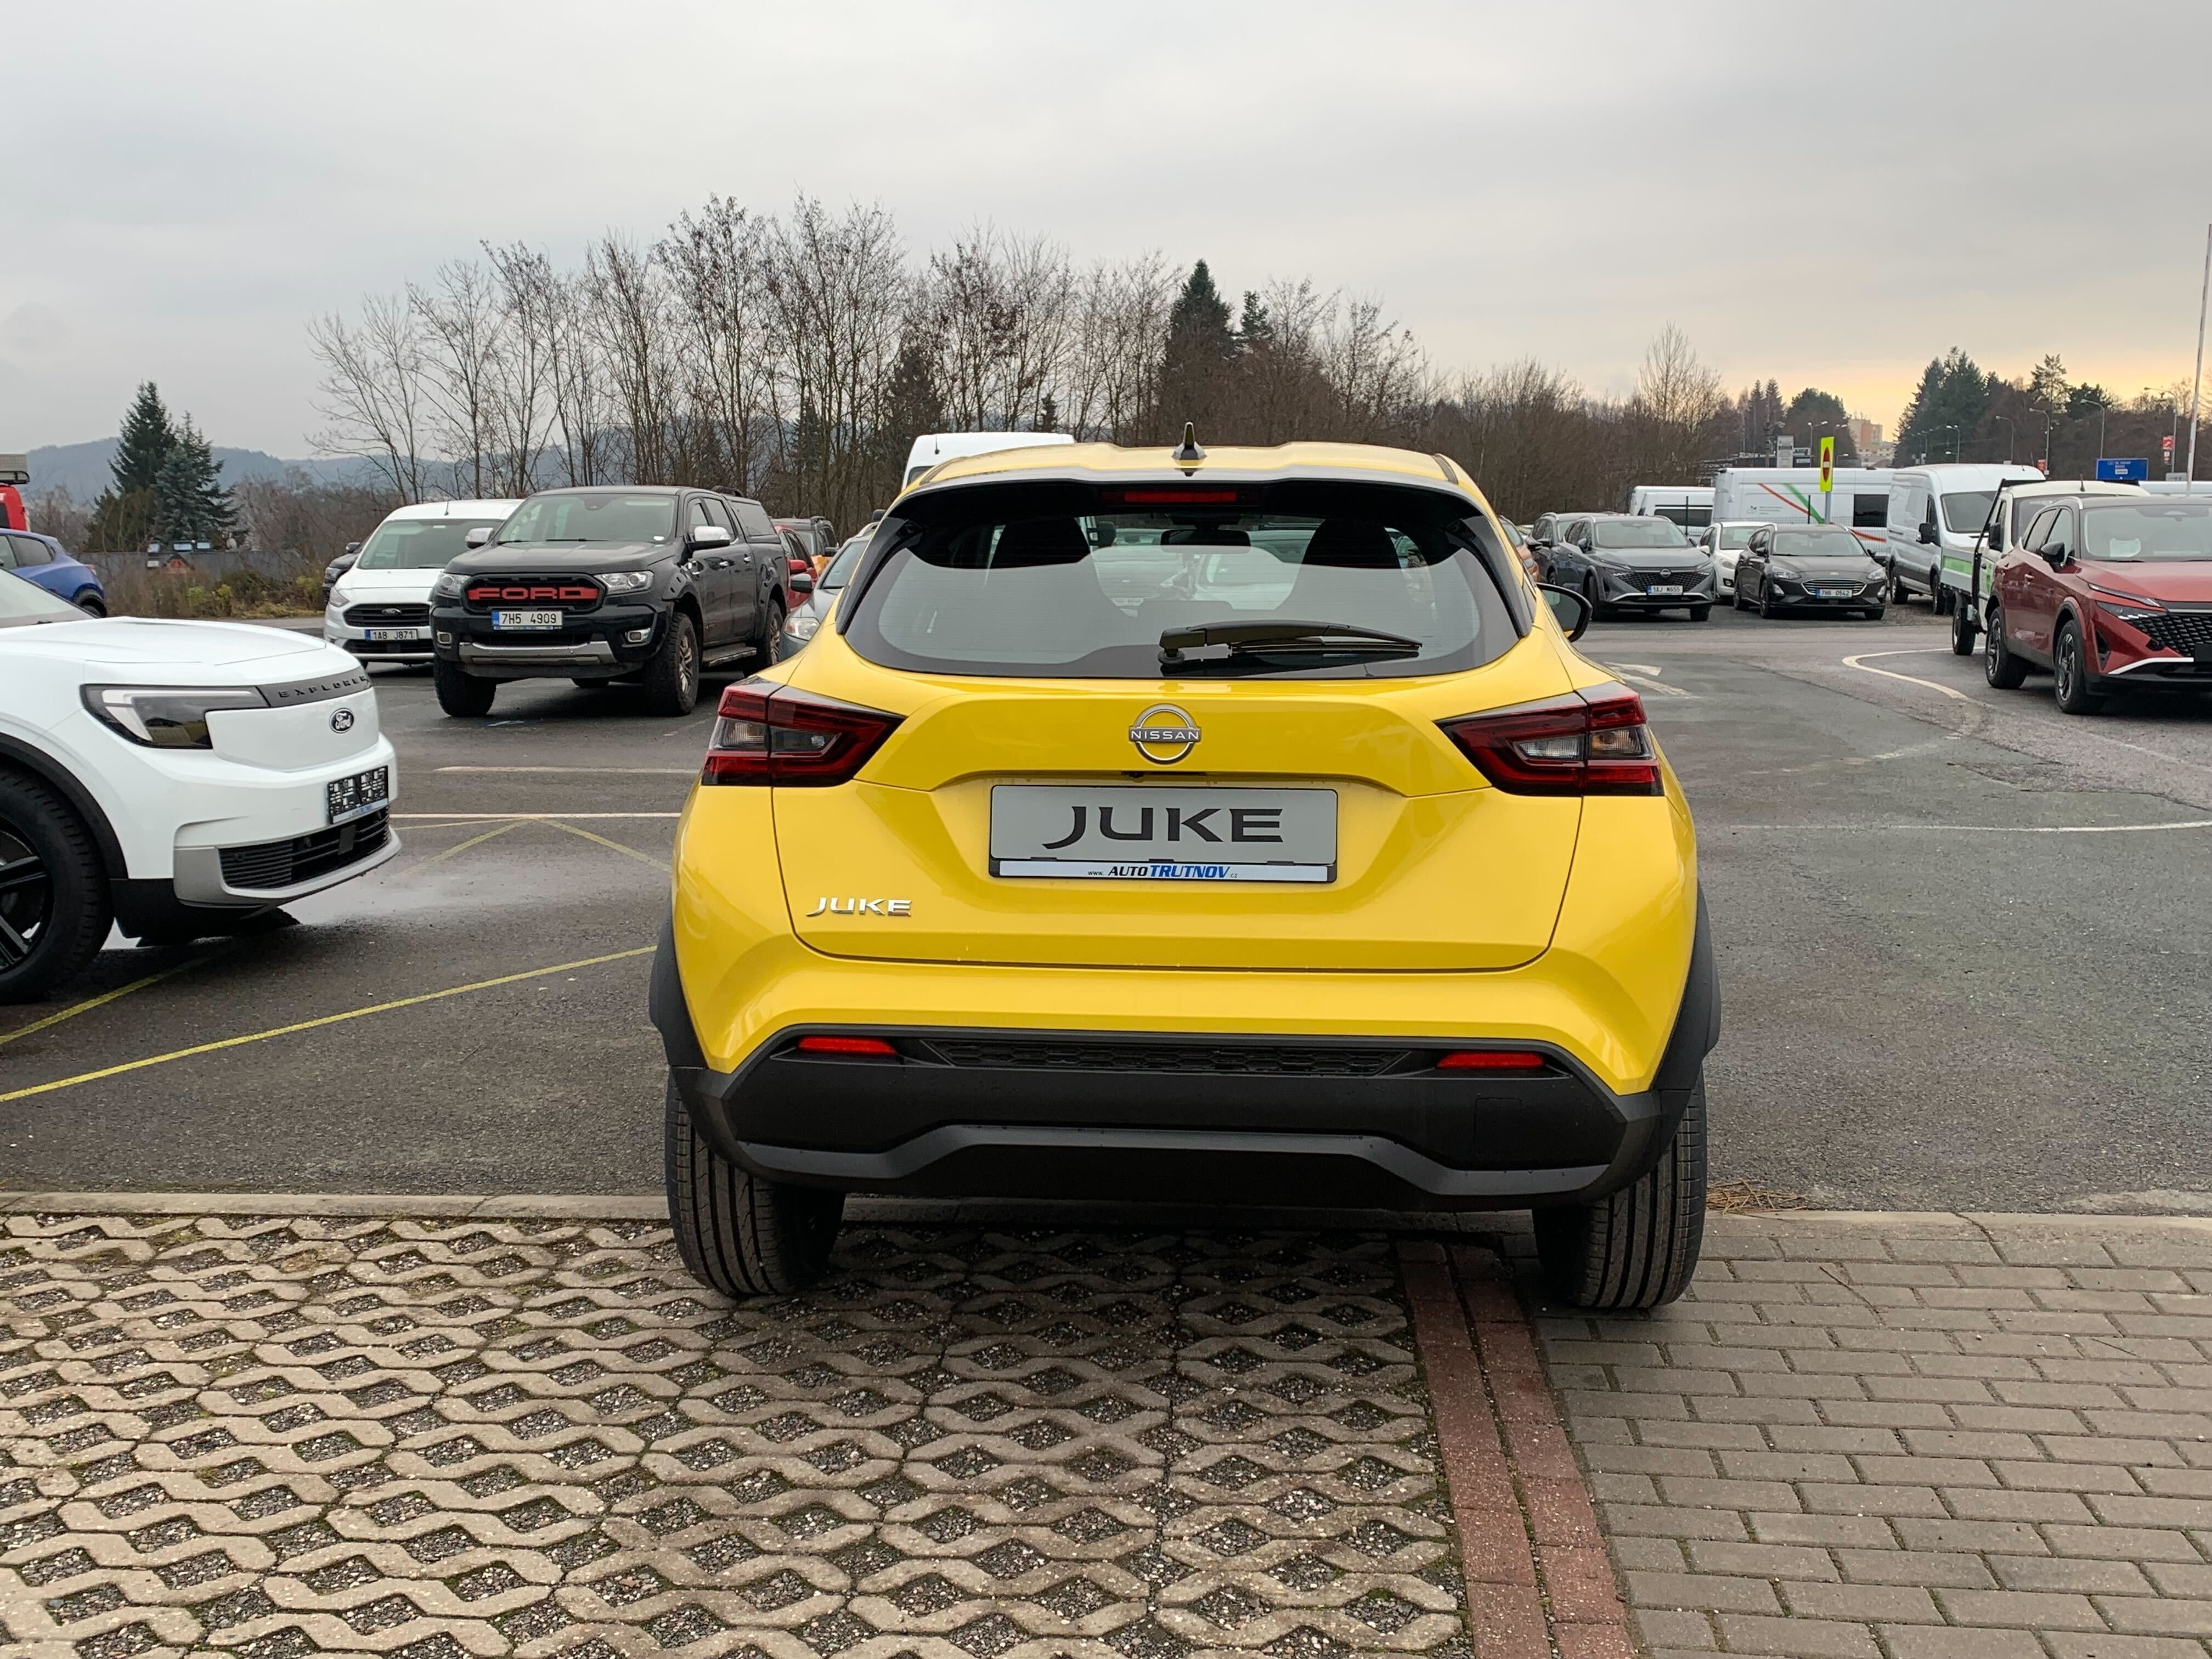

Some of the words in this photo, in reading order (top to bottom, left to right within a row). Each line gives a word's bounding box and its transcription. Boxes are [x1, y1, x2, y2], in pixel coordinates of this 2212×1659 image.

[467, 587, 599, 600] FORD
[501, 613, 521, 624] 7H5
[530, 613, 556, 624] 4909
[1131, 731, 1199, 740] NISSAN
[1042, 806, 1284, 849] JUKE
[806, 898, 912, 917] JUKE
